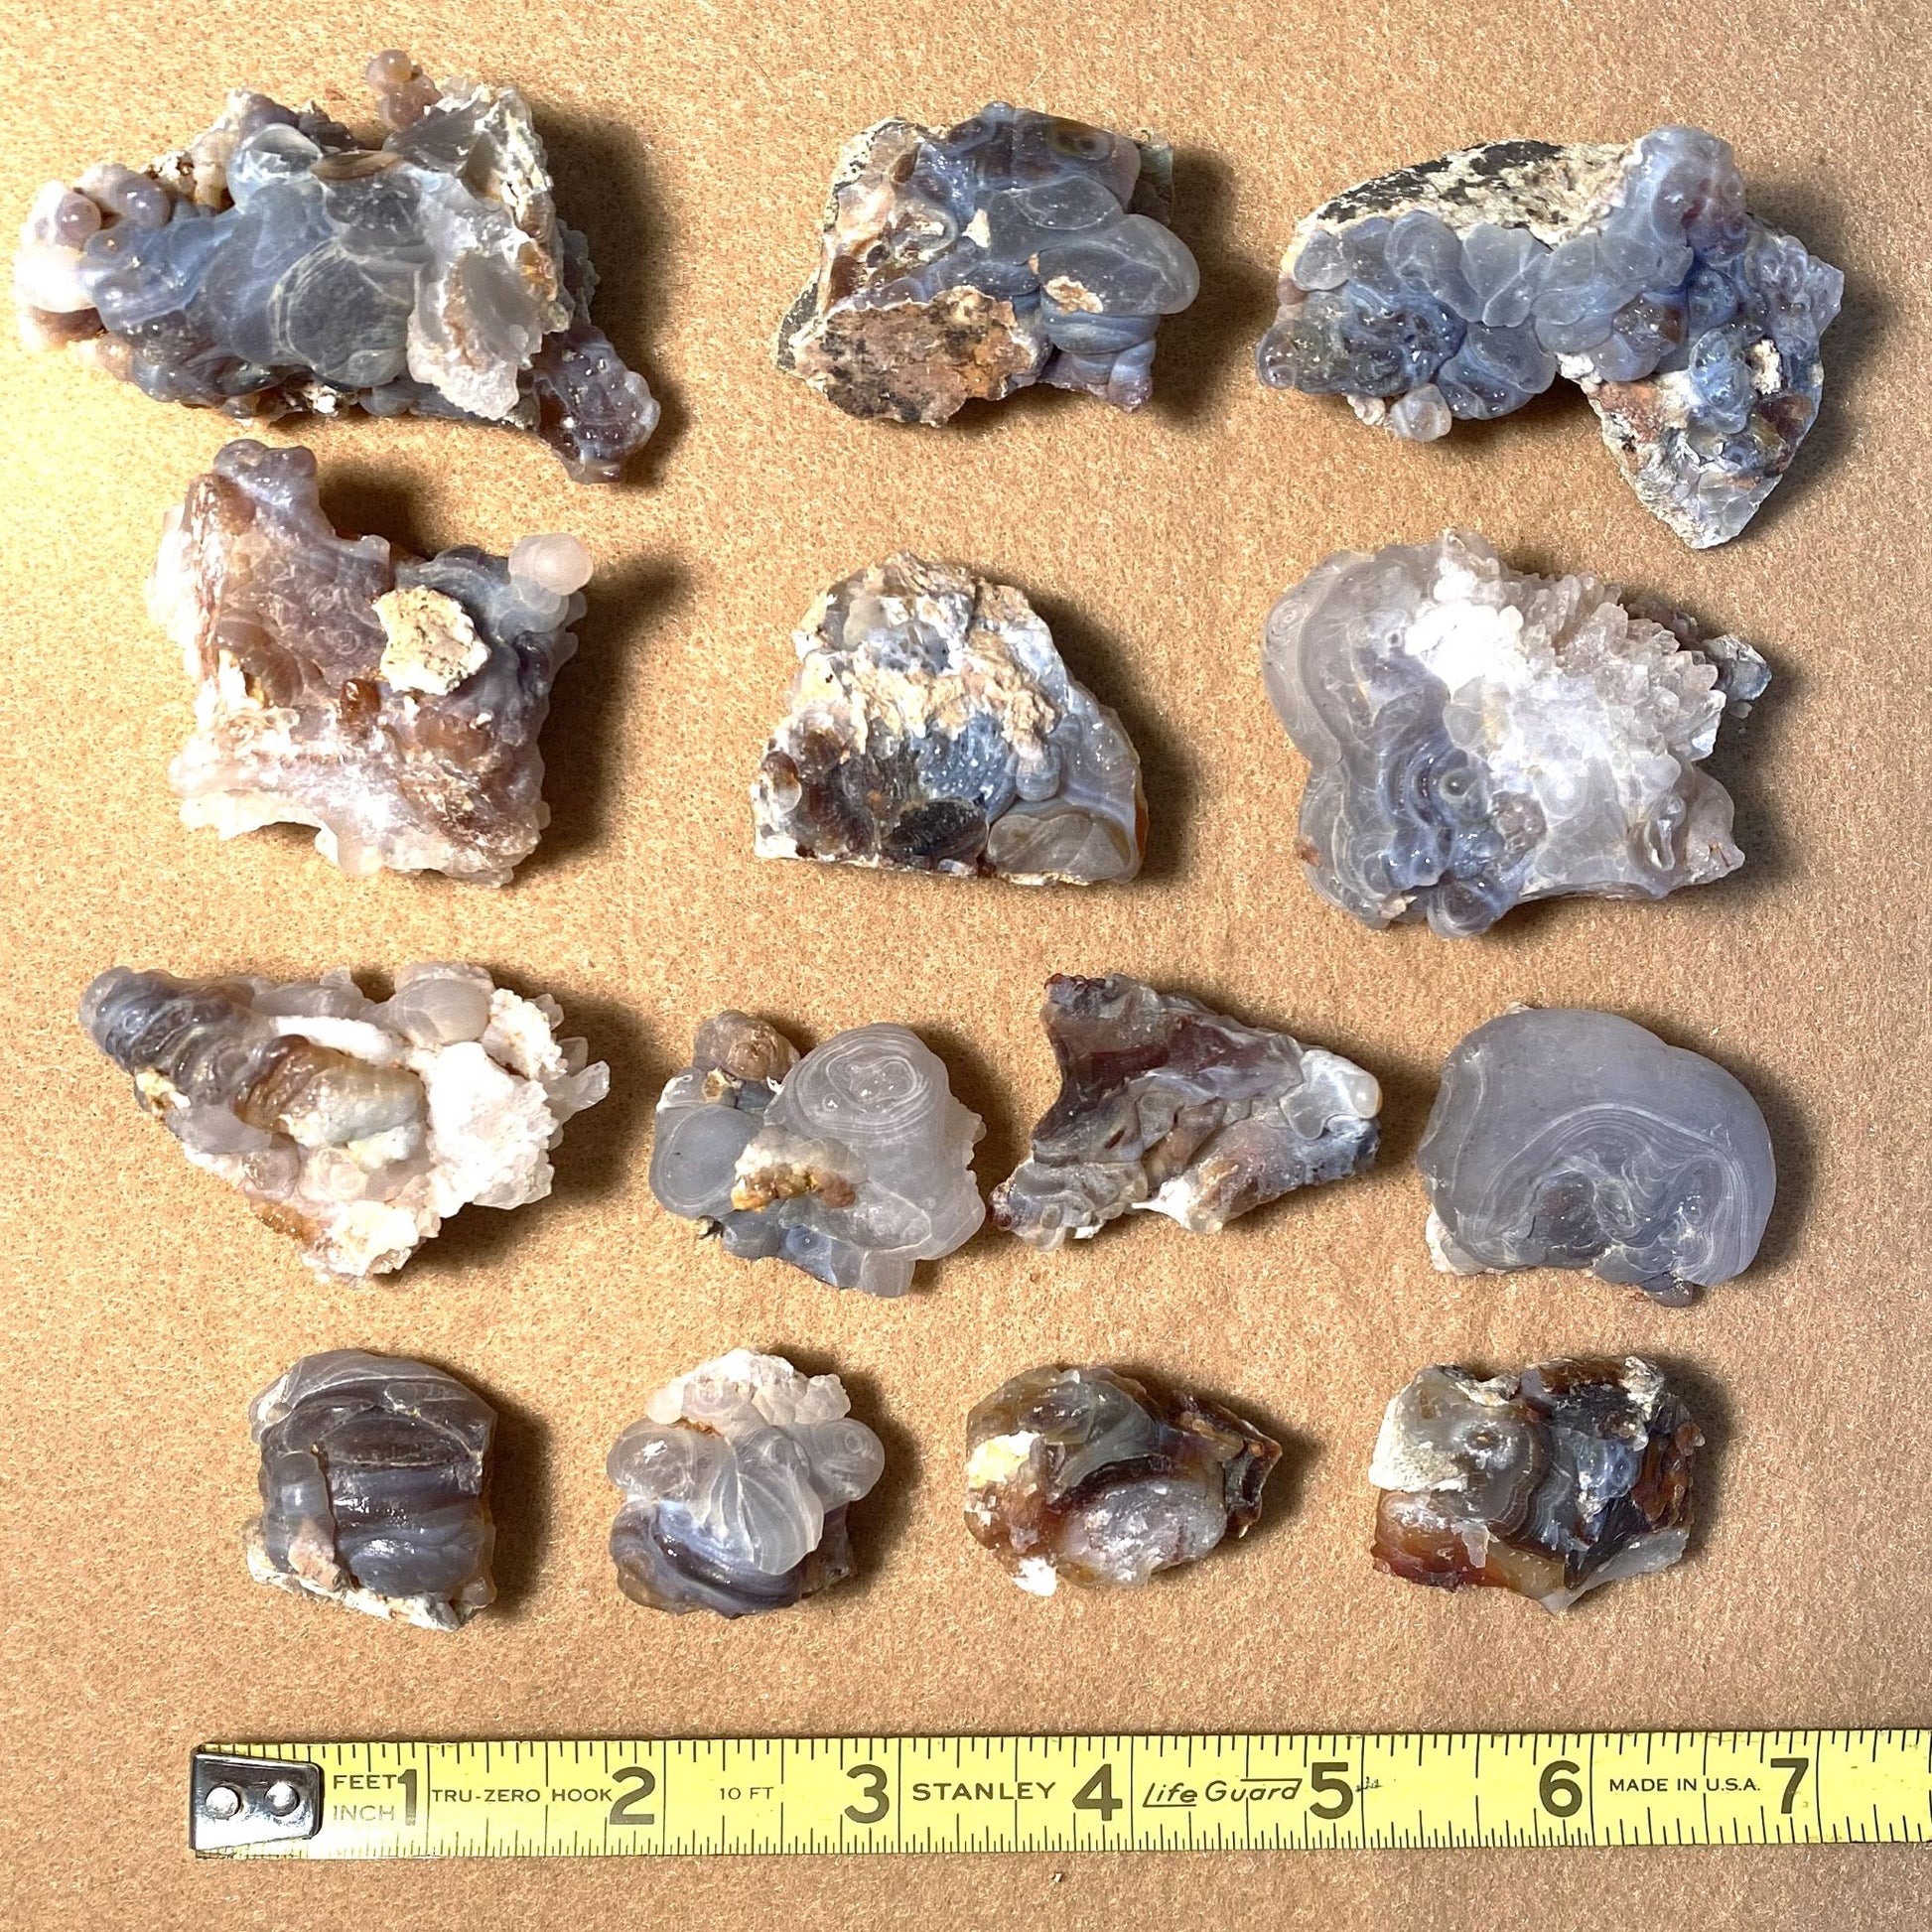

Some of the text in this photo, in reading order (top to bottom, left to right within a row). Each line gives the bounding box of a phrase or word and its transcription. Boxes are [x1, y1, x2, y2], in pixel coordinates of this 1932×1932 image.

[334, 1774, 397, 1790] FEET
[397, 1768, 418, 1826] 1
[432, 1788, 613, 1803] TRU-ZERO HOOK
[609, 1766, 656, 1826] 2
[719, 1786, 774, 1801] 10 FT
[844, 1763, 890, 1824] 3
[912, 1782, 1056, 1801] STANLEY
[1071, 1763, 1123, 1822] 4
[1309, 1761, 1354, 1820] 5
[1539, 1759, 1583, 1818] 6
[1609, 1777, 1761, 1792] MADE IN U.S.A.
[1769, 1757, 1810, 1815] 7
[333, 1805, 395, 1821] INCH
